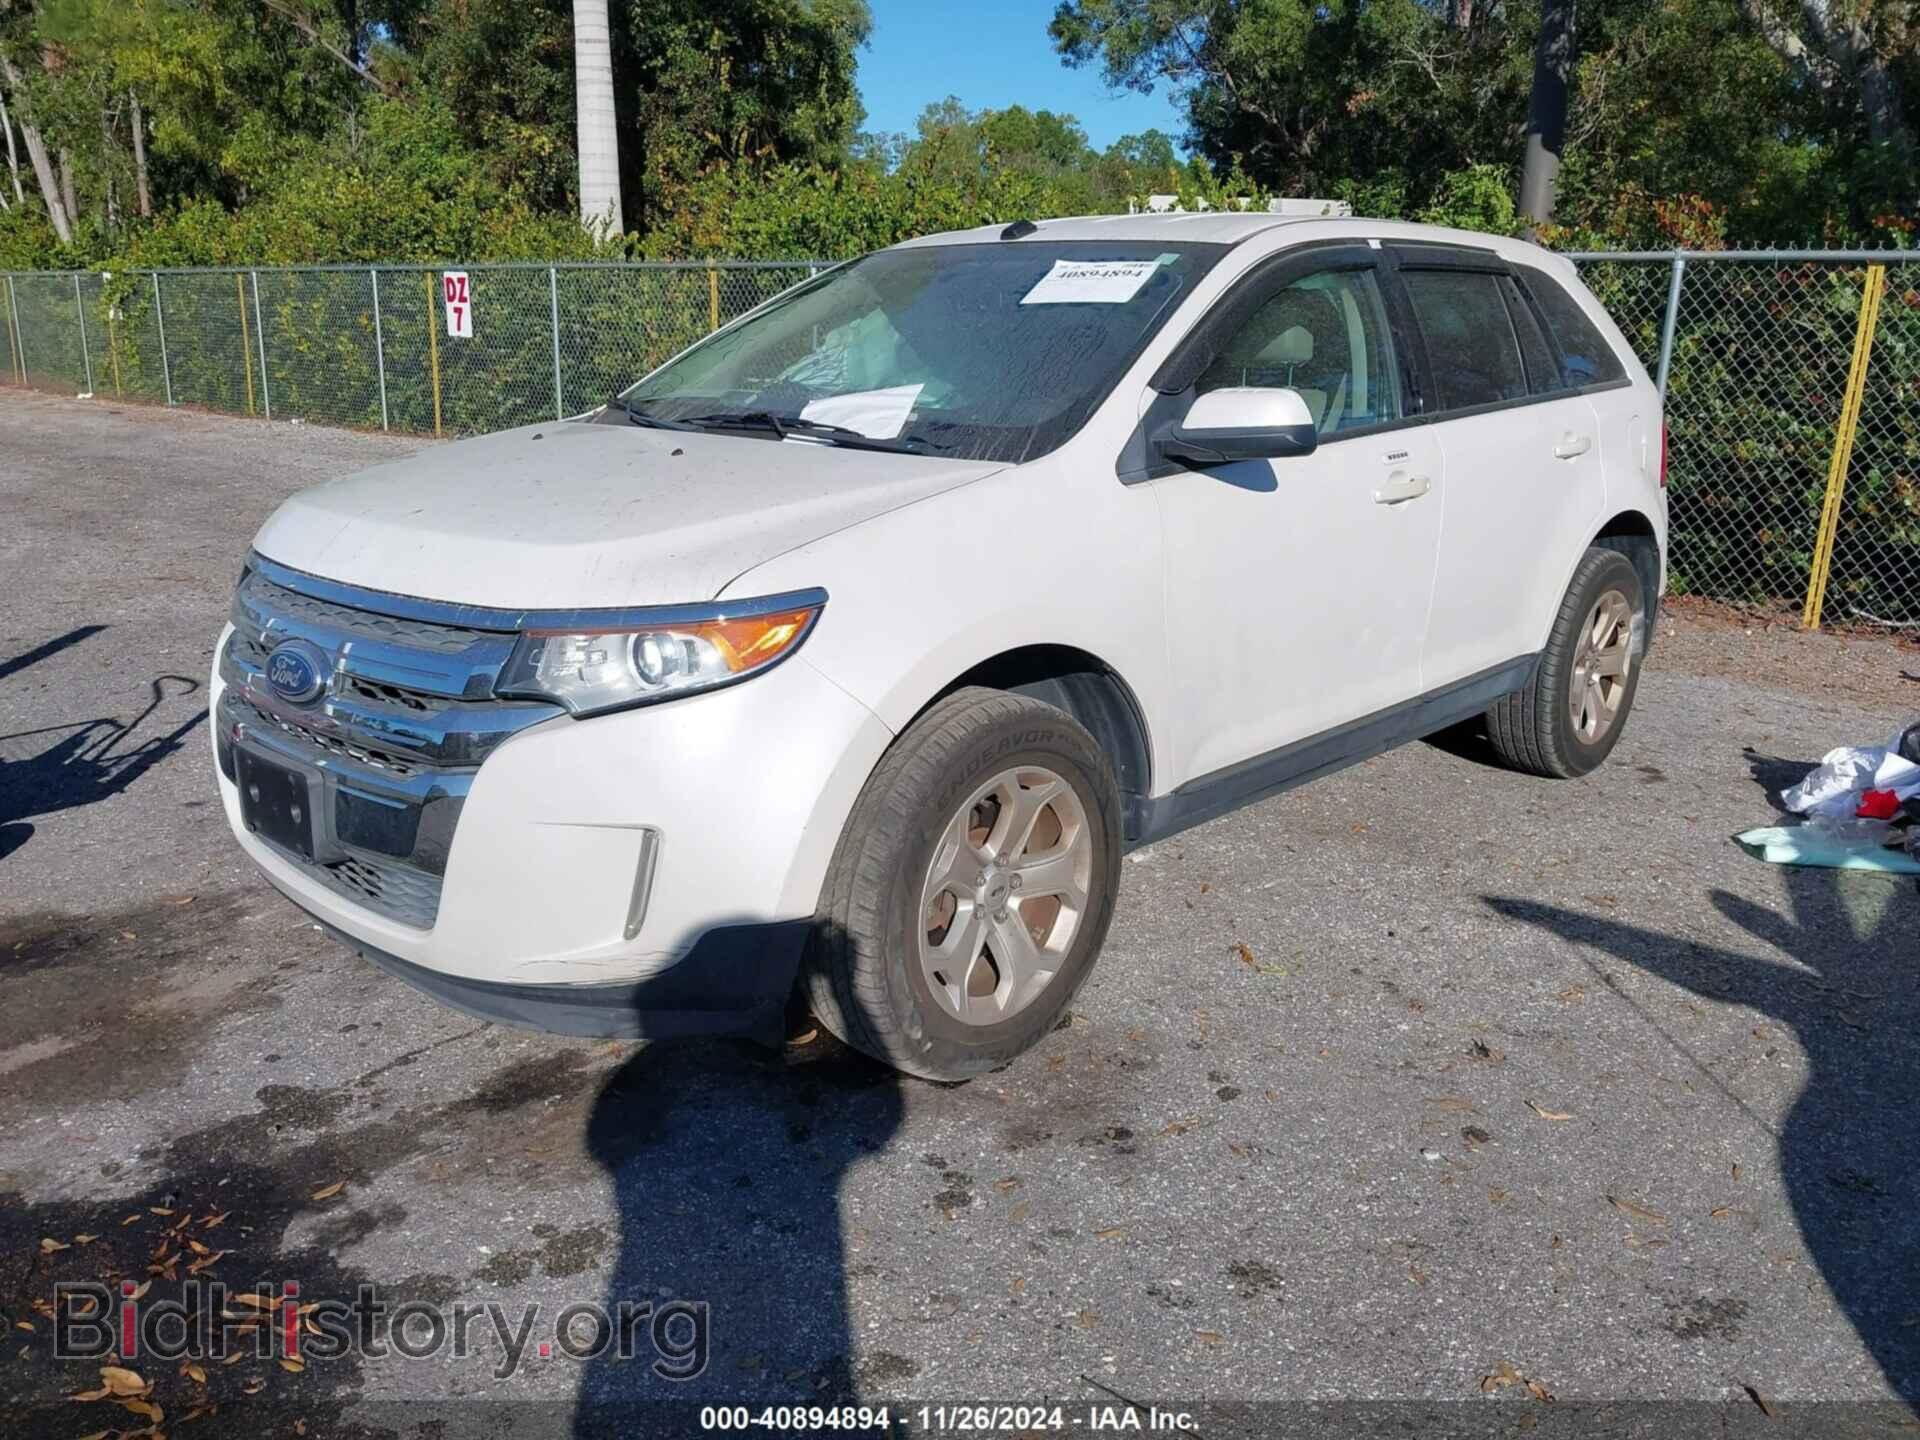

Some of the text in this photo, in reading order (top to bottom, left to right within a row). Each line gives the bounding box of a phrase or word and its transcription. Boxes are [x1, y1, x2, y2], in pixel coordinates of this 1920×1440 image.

[445, 276, 468, 303] DZ
[453, 306, 463, 332] 7
[271, 655, 303, 688] Ford
